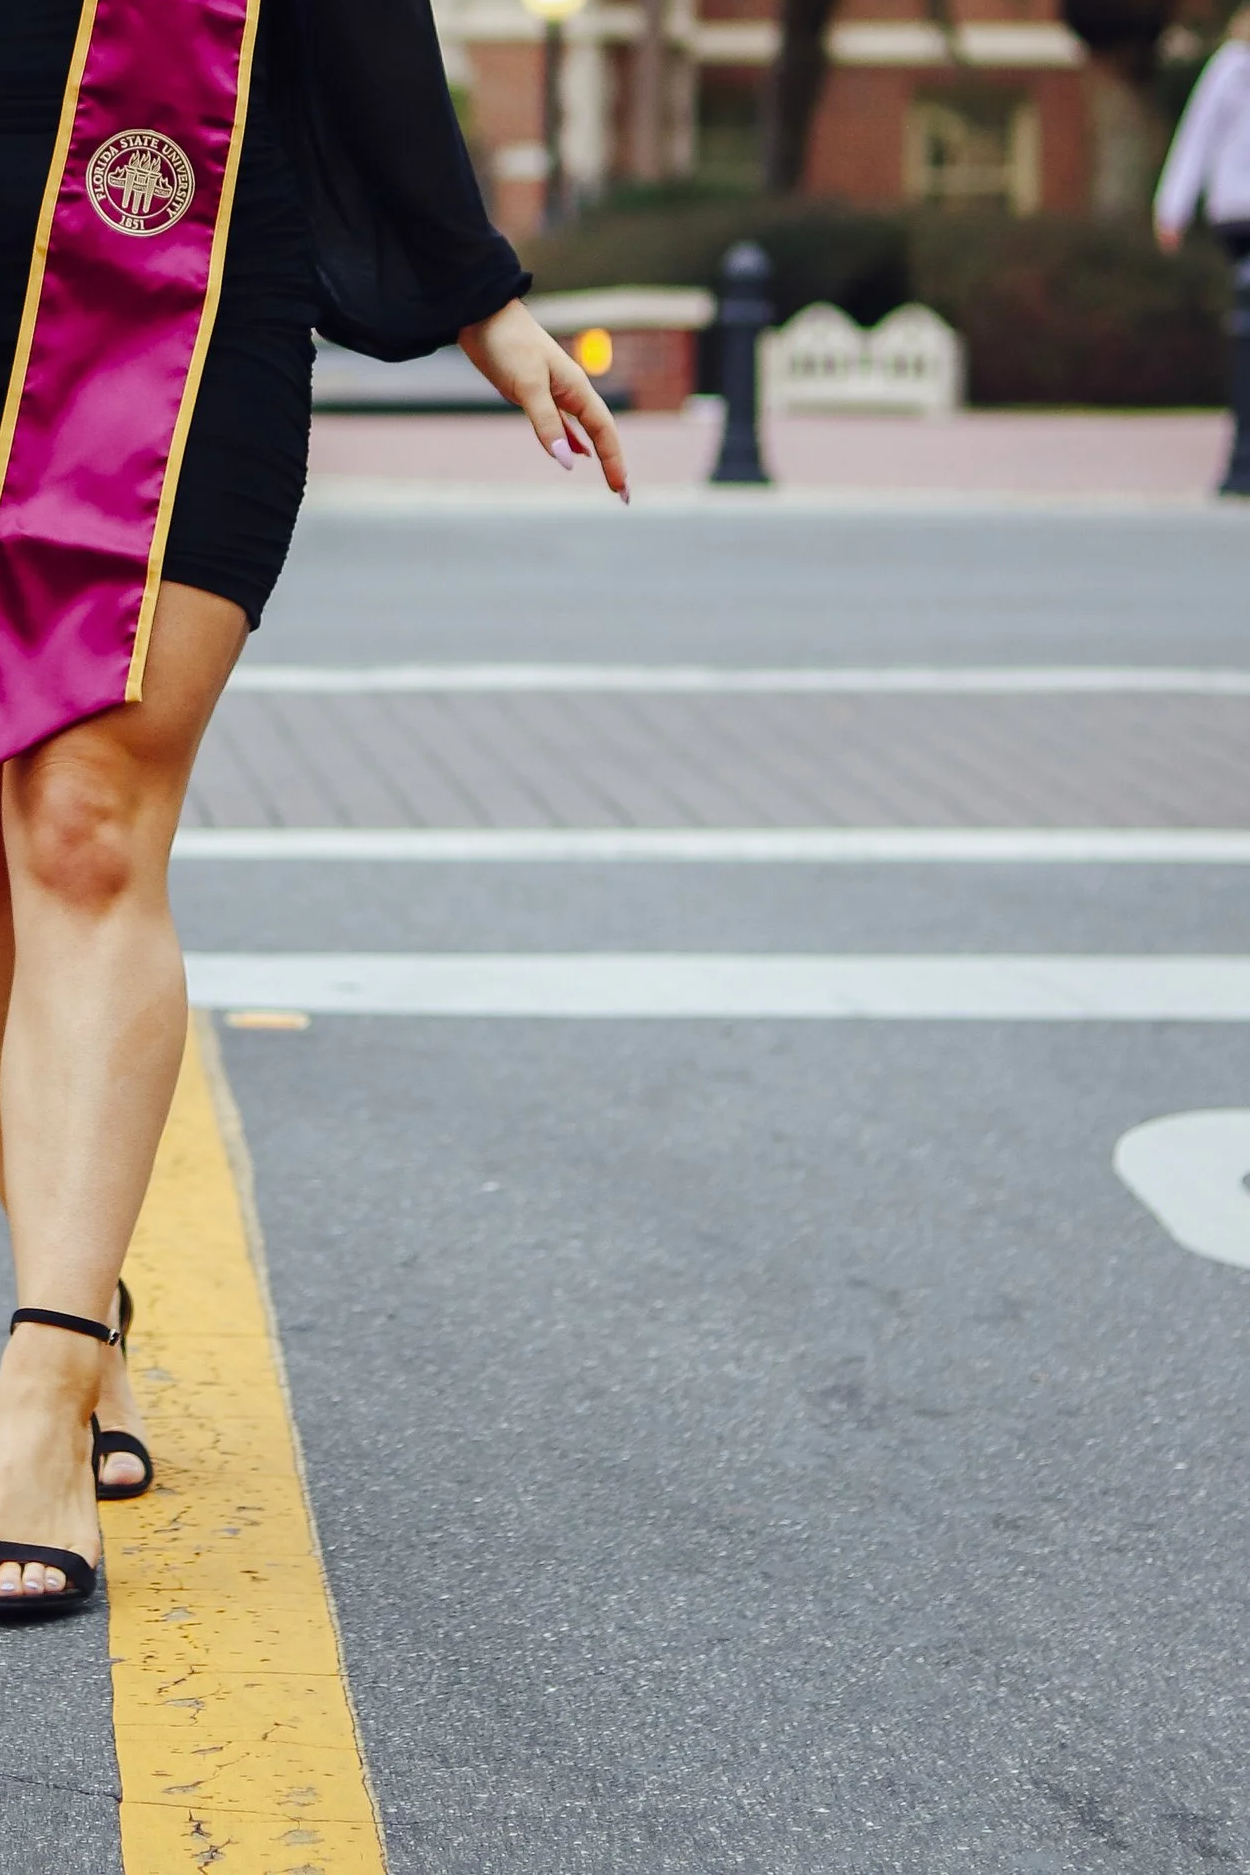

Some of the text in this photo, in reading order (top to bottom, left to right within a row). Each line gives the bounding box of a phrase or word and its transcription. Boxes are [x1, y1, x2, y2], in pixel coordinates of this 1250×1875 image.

[93, 135, 188, 218] FLORIDA STATE UNIVERSITY
[119, 215, 146, 230] 1851
